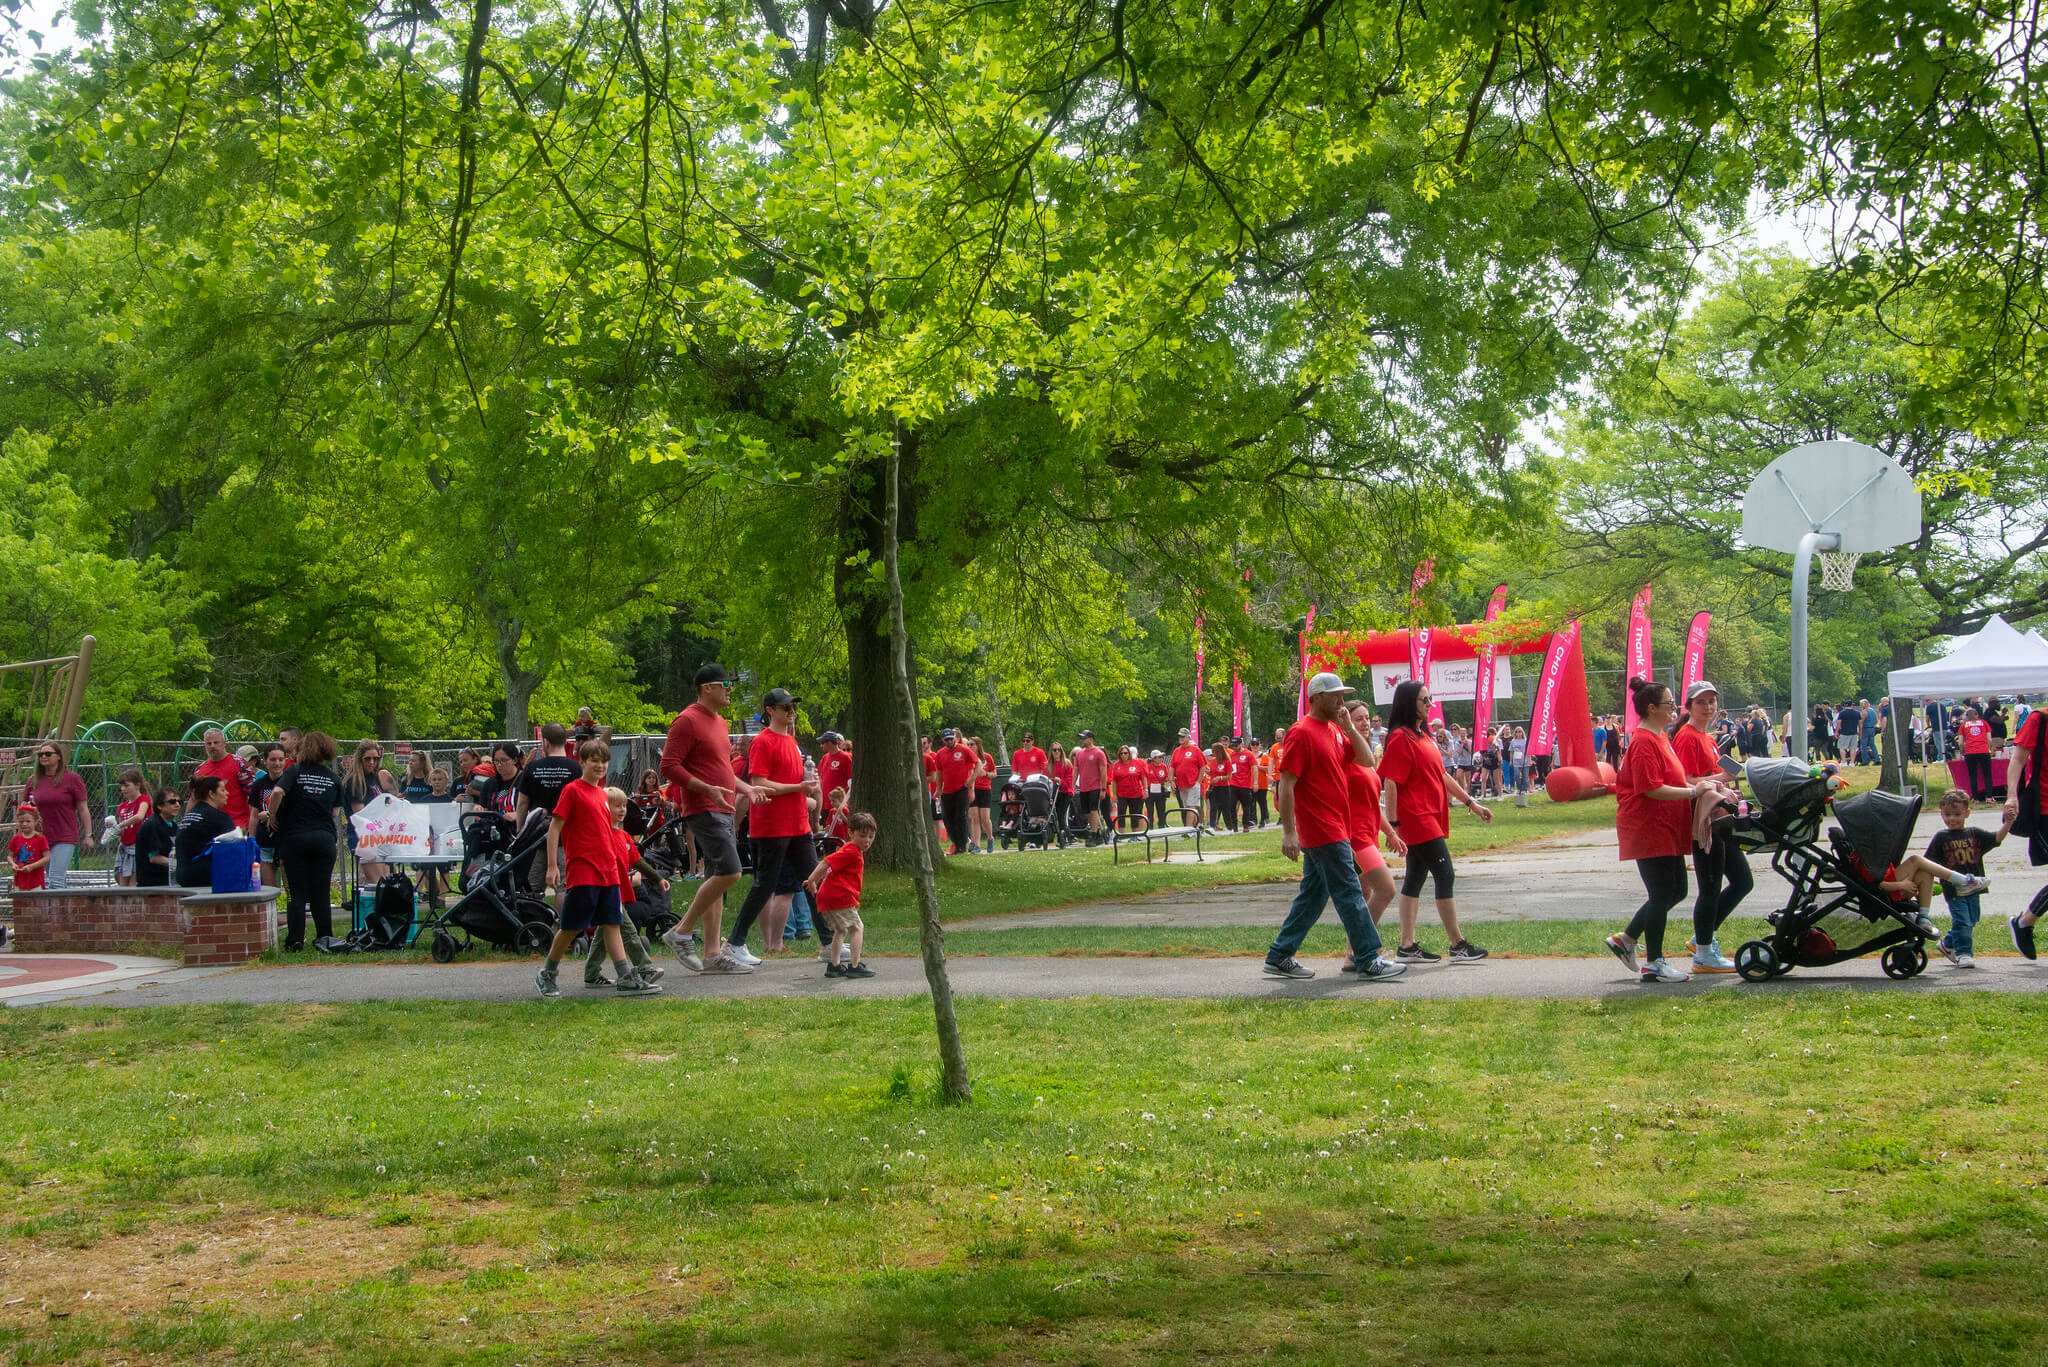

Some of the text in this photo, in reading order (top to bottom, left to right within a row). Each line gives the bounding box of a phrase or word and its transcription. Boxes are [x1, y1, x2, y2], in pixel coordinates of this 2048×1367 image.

[1634, 625, 1644, 667] Thank
[1537, 646, 1564, 746] CHD Research!
